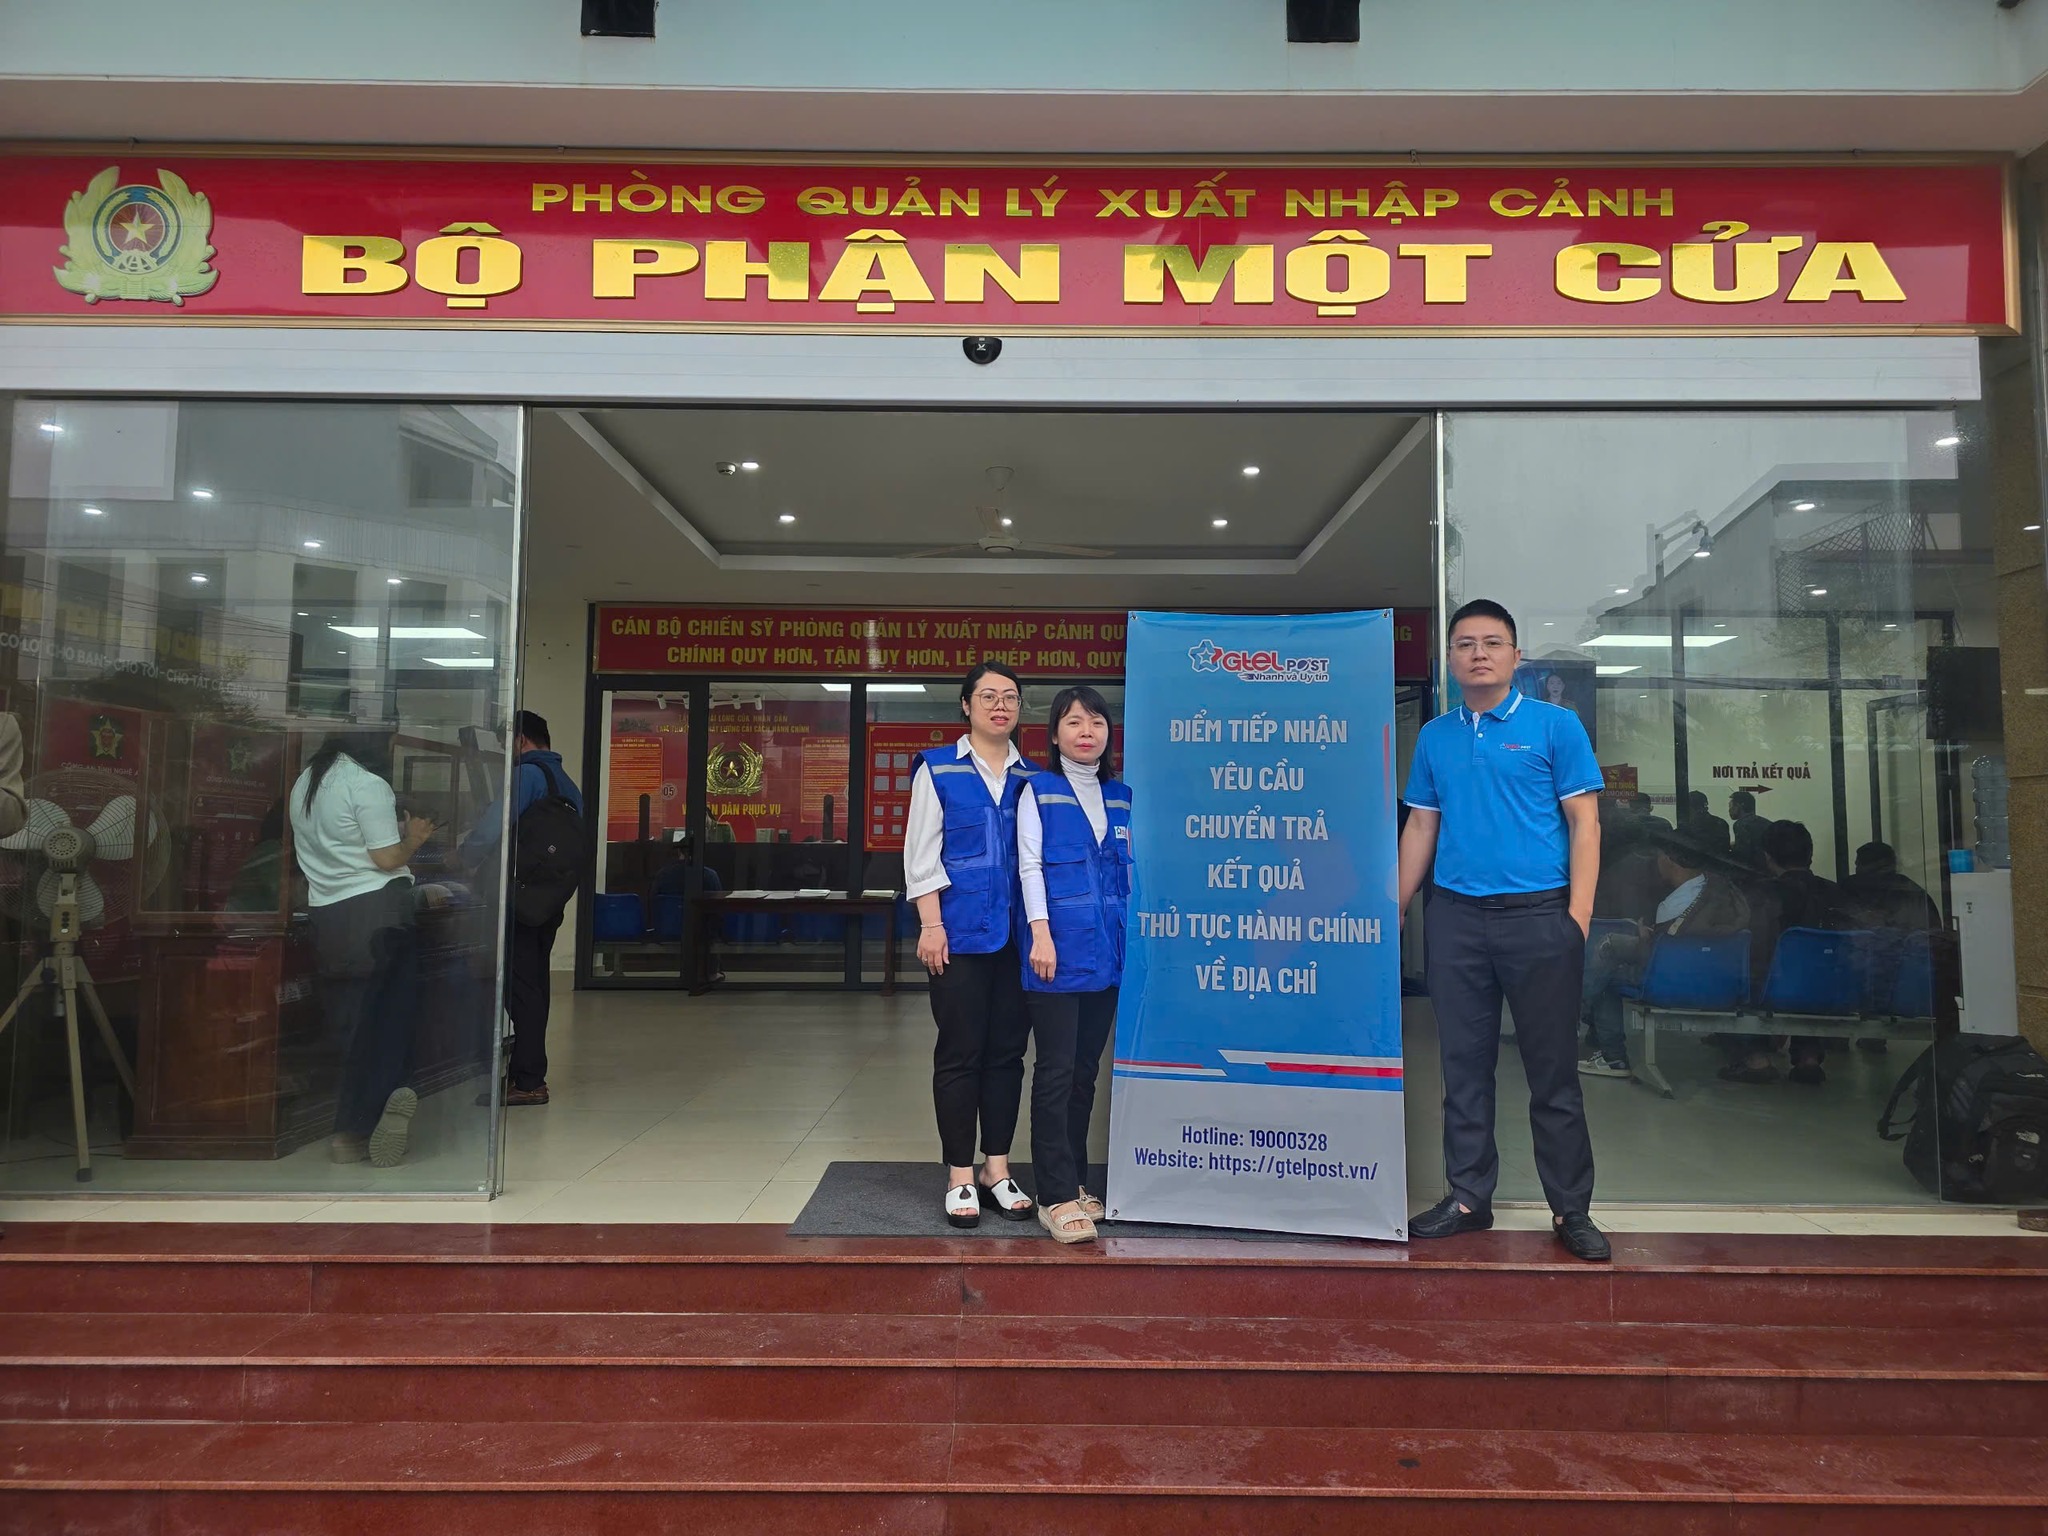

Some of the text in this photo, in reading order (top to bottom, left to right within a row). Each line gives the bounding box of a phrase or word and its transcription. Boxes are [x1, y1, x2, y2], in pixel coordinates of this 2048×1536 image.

[531, 169, 1674, 225] PHÒNG QUẢN LÝ XUẤT NHẬP CẢNH
[301, 219, 1908, 317] BỘ PHẬN MỘT CỬA
[611, 615, 650, 636] CÁN
[656, 616, 682, 639] BỘ
[687, 615, 744, 637] CHIẾN
[750, 616, 774, 637] SỸ
[780, 617, 844, 638] PHÒNG
[850, 617, 901, 640] QUẢN
[907, 618, 929, 640] LÝ
[934, 617, 981, 640] XUẤT
[986, 620, 1038, 643] NHẬP
[1044, 618, 1094, 640] CẢNH
[1100, 623, 1127, 641] QU
[667, 643, 725, 664] CHÍNH
[731, 646, 767, 665] QUY
[824, 646, 860, 669] TẬN
[956, 644, 977, 667] LỄ
[982, 647, 1031, 667] PHÉP
[1087, 651, 1127, 669] QUY
[1286, 658, 1328, 672] POST
[1252, 673, 1284, 681] Nhanh
[1300, 673, 1313, 683] Uy
[1170, 709, 1347, 750] ĐIỂM TIẾP NHẬN
[1210, 758, 1304, 791] YÊU CẦU
[1712, 761, 1811, 780] NƠI TRẢ KẾT QUẢ
[663, 786, 674, 797] 05
[743, 803, 766, 818] PHỤC
[769, 803, 781, 818] VỤ
[1185, 804, 1328, 841] CHUYỂN TRẢ
[1207, 856, 1305, 892] KẾT QUẢ
[1137, 905, 1381, 946] THỦ TỤC HÀNH CHÍNH
[1195, 955, 1319, 1000] VỀ ĐỊA CHỈ
[1181, 1125, 1328, 1151] Hotline: 19000328
[1134, 1147, 1379, 1181] Website: https://gtelpost.vn/
